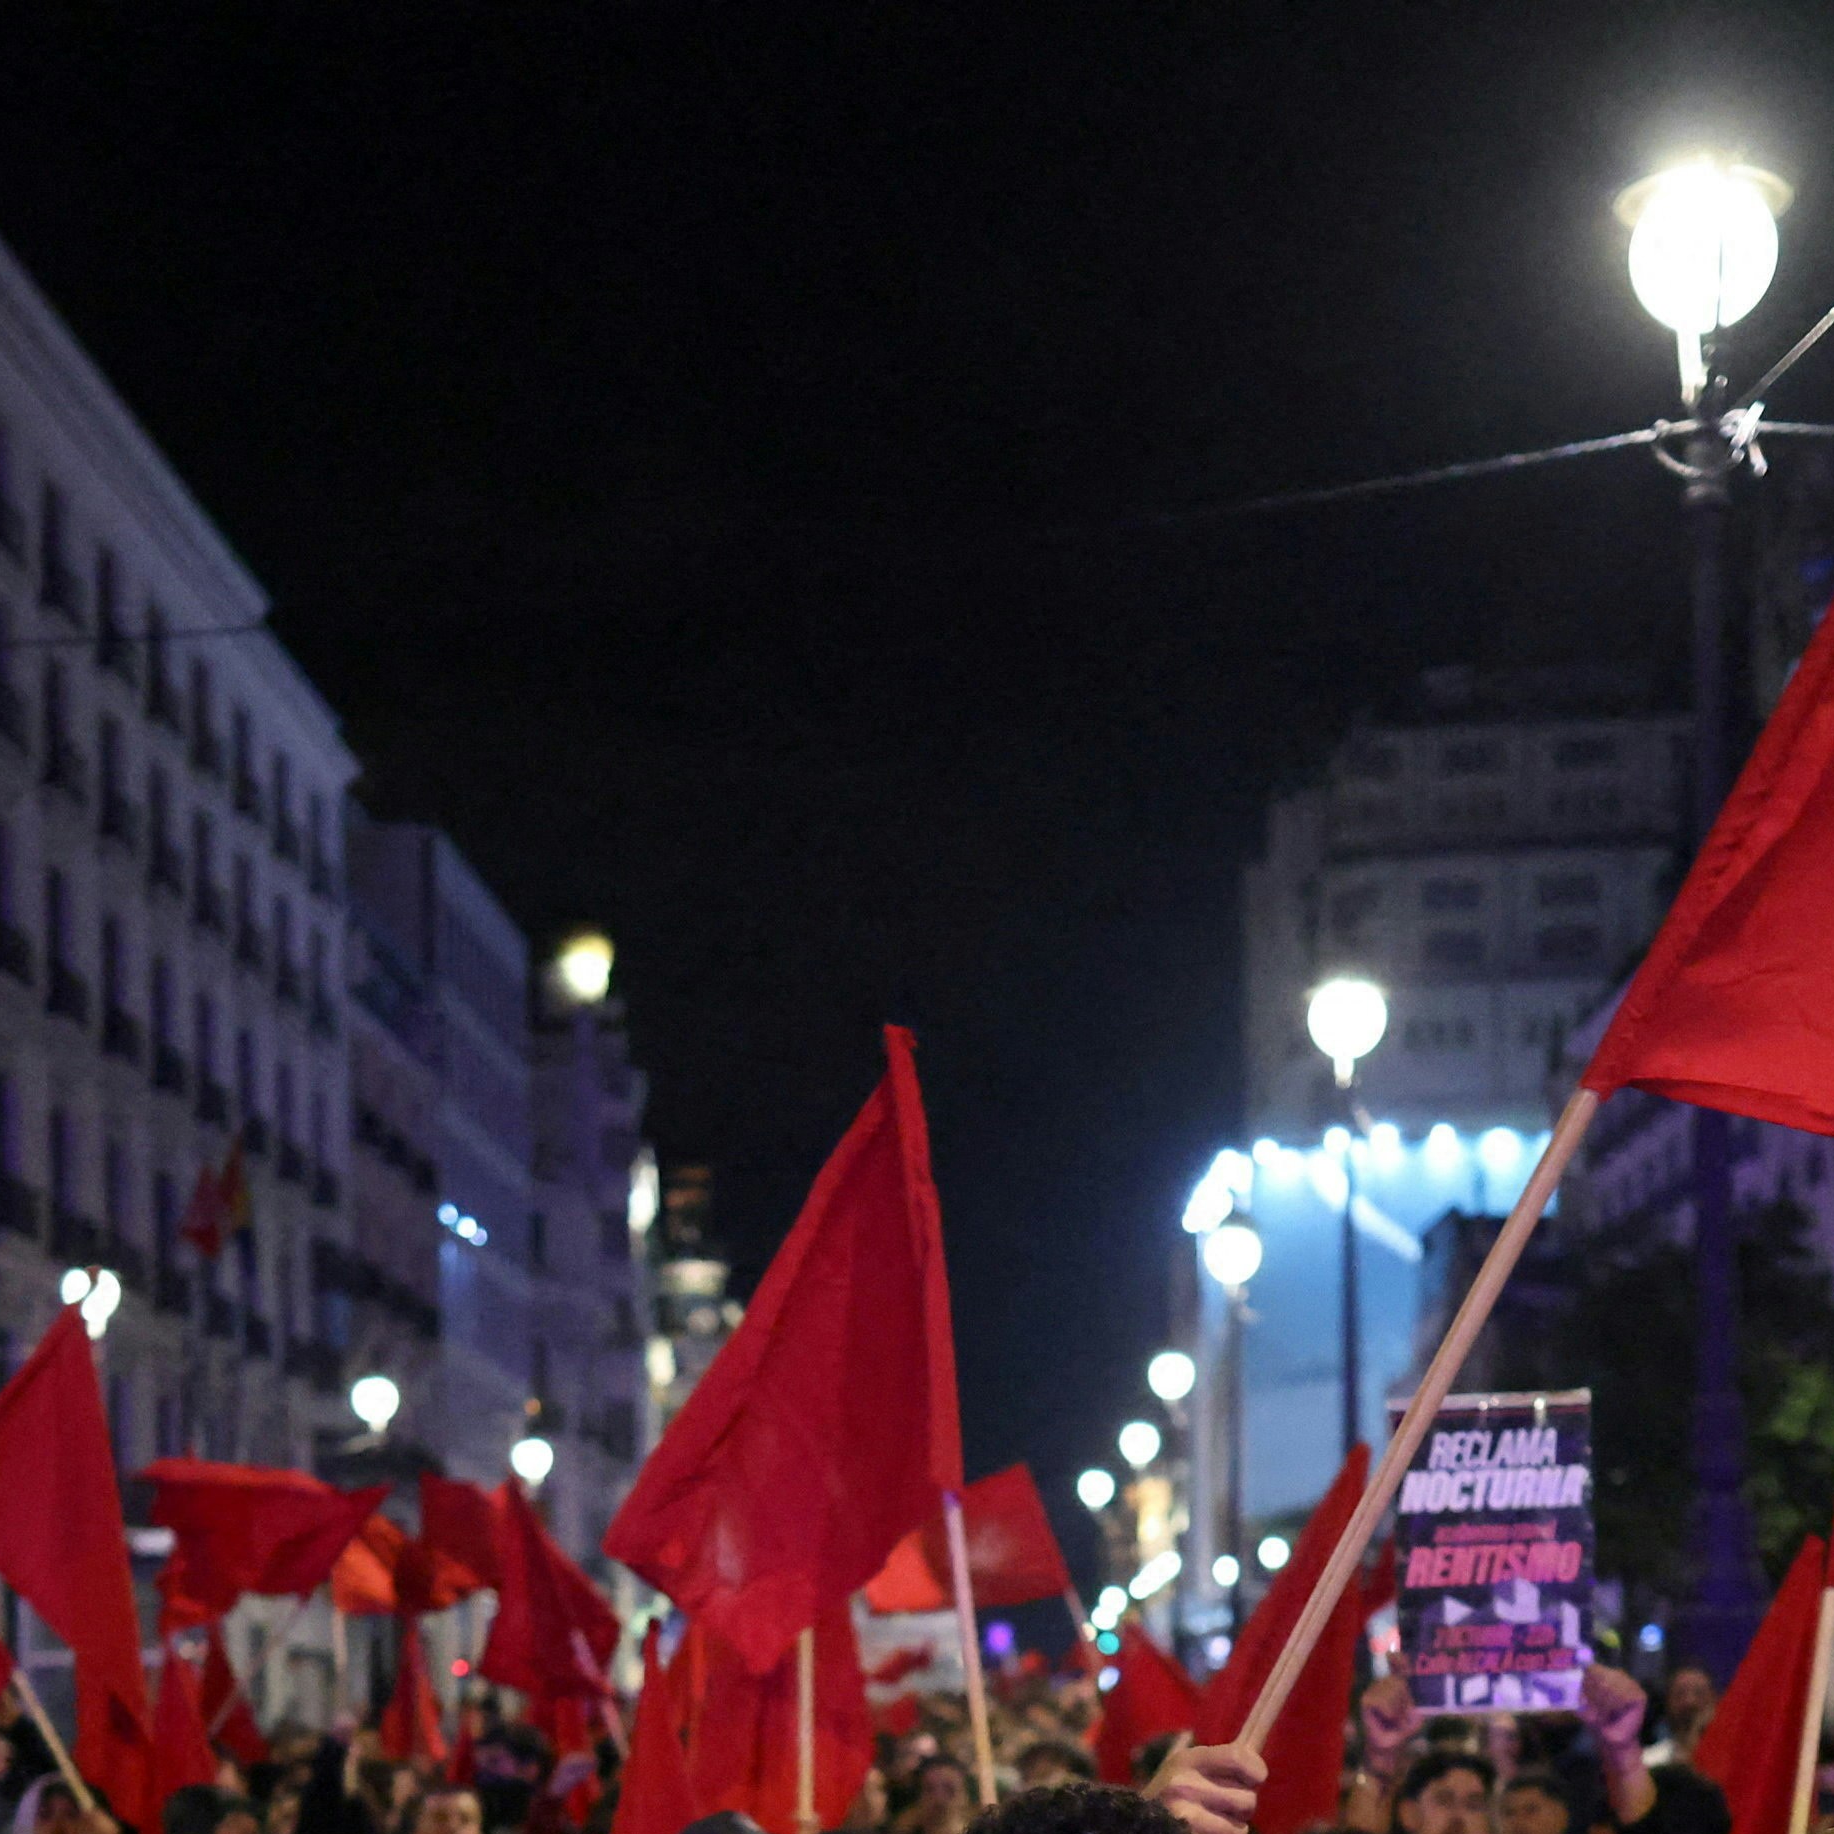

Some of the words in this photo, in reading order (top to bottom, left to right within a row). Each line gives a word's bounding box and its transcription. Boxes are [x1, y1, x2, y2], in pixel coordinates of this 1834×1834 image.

[1428, 1427, 1558, 1470] RECLAMA
[1398, 1464, 1588, 1514] NOCTURNA
[1404, 1541, 1583, 1589] RENTISMO
